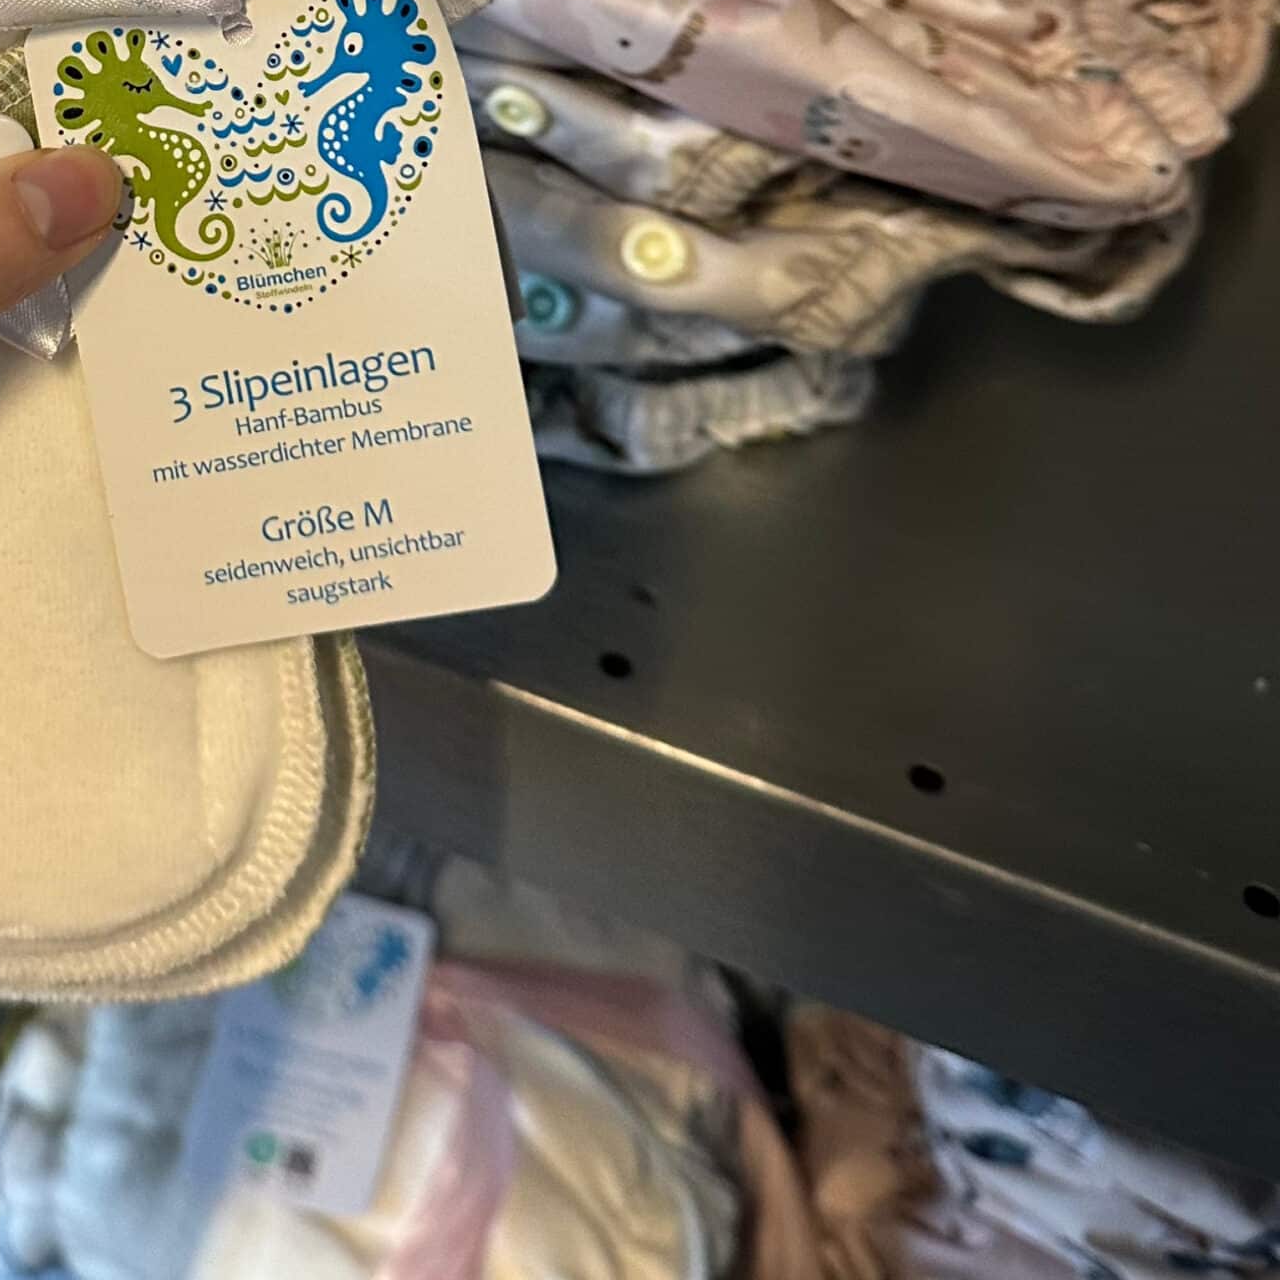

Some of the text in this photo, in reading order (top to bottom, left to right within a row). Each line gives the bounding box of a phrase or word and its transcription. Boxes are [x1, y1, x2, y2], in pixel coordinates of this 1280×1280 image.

[236, 265, 328, 292] Blümchen
[170, 345, 436, 423] 3 Slipeinlagen
[235, 397, 383, 436] Hanf-Bambus
[152, 414, 473, 483] mit wasserdichter Membrane
[261, 498, 393, 543] Größe M
[204, 528, 465, 585] seidenweich, unsichtbar
[286, 571, 393, 605] saugstark
